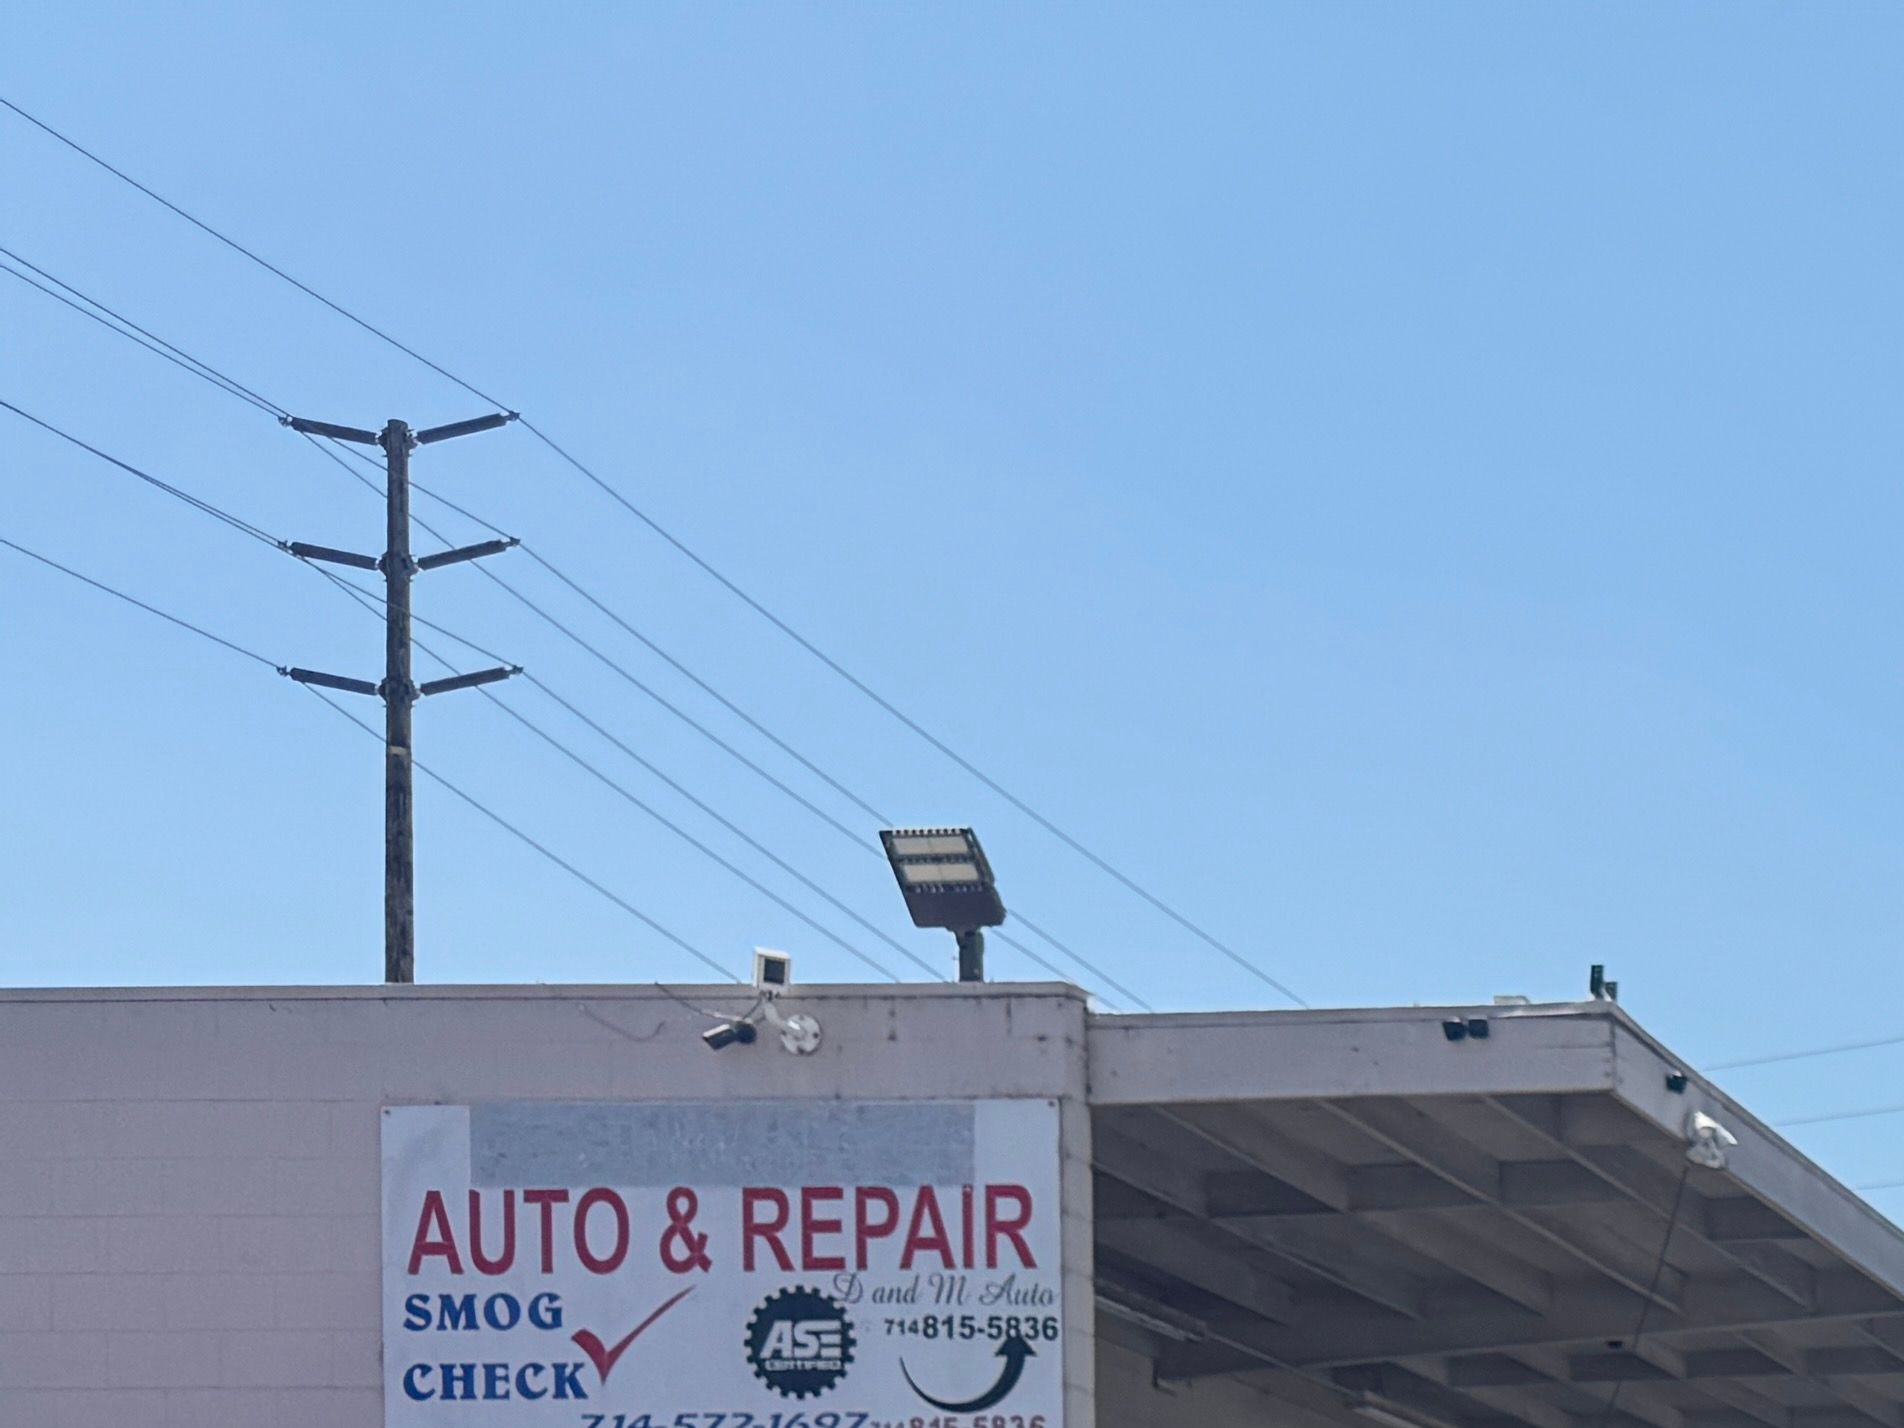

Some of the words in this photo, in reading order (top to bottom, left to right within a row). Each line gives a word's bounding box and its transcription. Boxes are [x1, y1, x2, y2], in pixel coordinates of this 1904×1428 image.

[406, 1188, 630, 1276] AUTO
[659, 1187, 712, 1274] &
[741, 1182, 1037, 1273] REPAIR
[833, 1273, 863, 1305] D
[873, 1274, 919, 1304] and
[928, 1273, 967, 1306] M
[979, 1273, 1054, 1307] Auto
[403, 1292, 564, 1331] SMOG
[759, 1320, 842, 1359] ASE
[403, 1361, 590, 1400] CHECK
